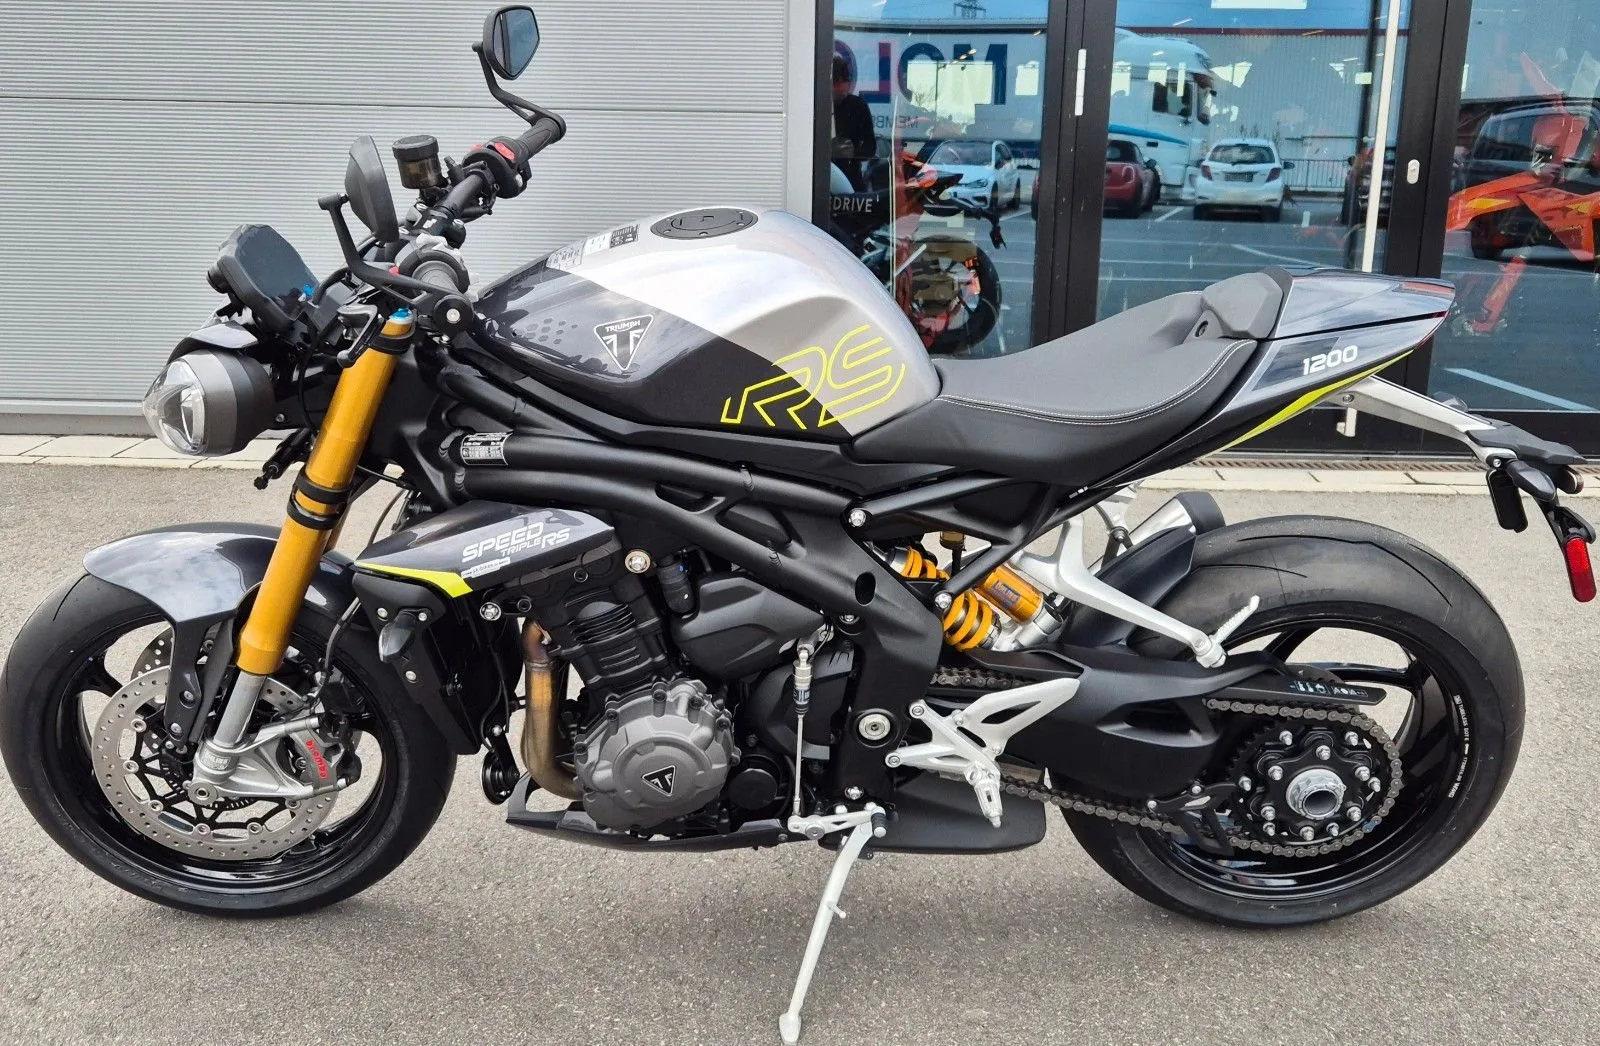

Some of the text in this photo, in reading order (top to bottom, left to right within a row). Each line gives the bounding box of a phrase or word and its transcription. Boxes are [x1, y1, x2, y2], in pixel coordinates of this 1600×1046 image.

[832, 196, 873, 213] DRIVE
[605, 320, 641, 333] TRIUMPH
[1302, 345, 1359, 376] 1200
[720, 324, 906, 430] RS
[461, 521, 545, 563] SPEED
[500, 527, 571, 557] TRIPLE RS
[305, 739, 329, 780] brembo
